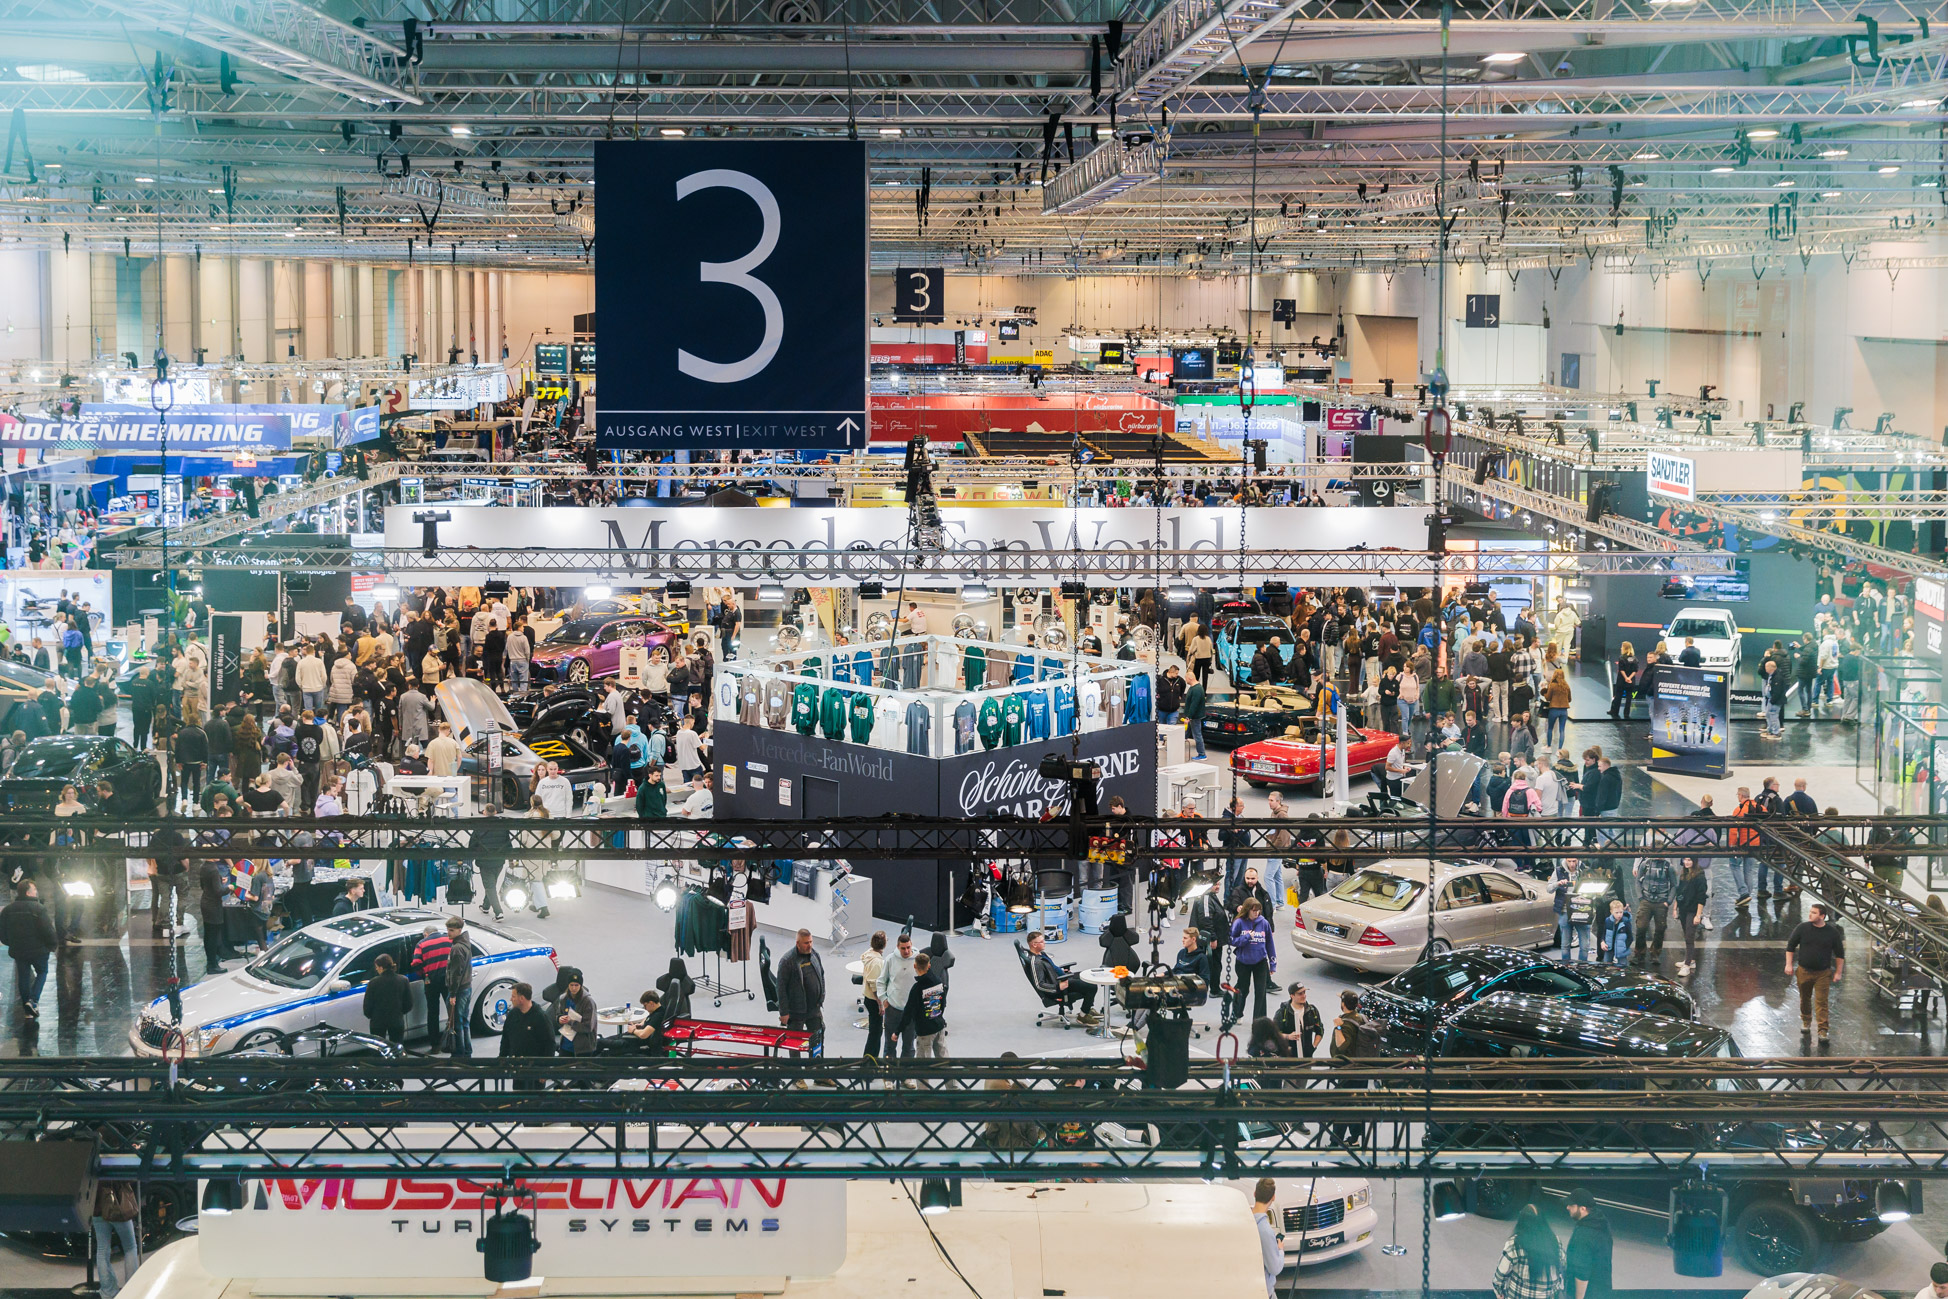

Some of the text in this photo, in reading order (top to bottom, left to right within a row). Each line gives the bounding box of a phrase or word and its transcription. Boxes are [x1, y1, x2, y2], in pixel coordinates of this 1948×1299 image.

[676, 169, 784, 383] 3
[910, 273, 931, 311] 3
[1275, 301, 1283, 312] 2
[1469, 297, 1476, 312] 1
[533, 387, 569, 399] DTM
[1332, 413, 1365, 424] CSR
[2, 423, 264, 442] HOCKENHEIMRING
[605, 426, 828, 437] AUSGANG WEST EXIT WEST
[1651, 456, 1690, 485] SANDTLER
[216, 634, 225, 691] WRAPPING WORLD
[751, 735, 894, 782] Mercedes-FanWorld
[568, 1219, 780, 1233] SYSTEMS
